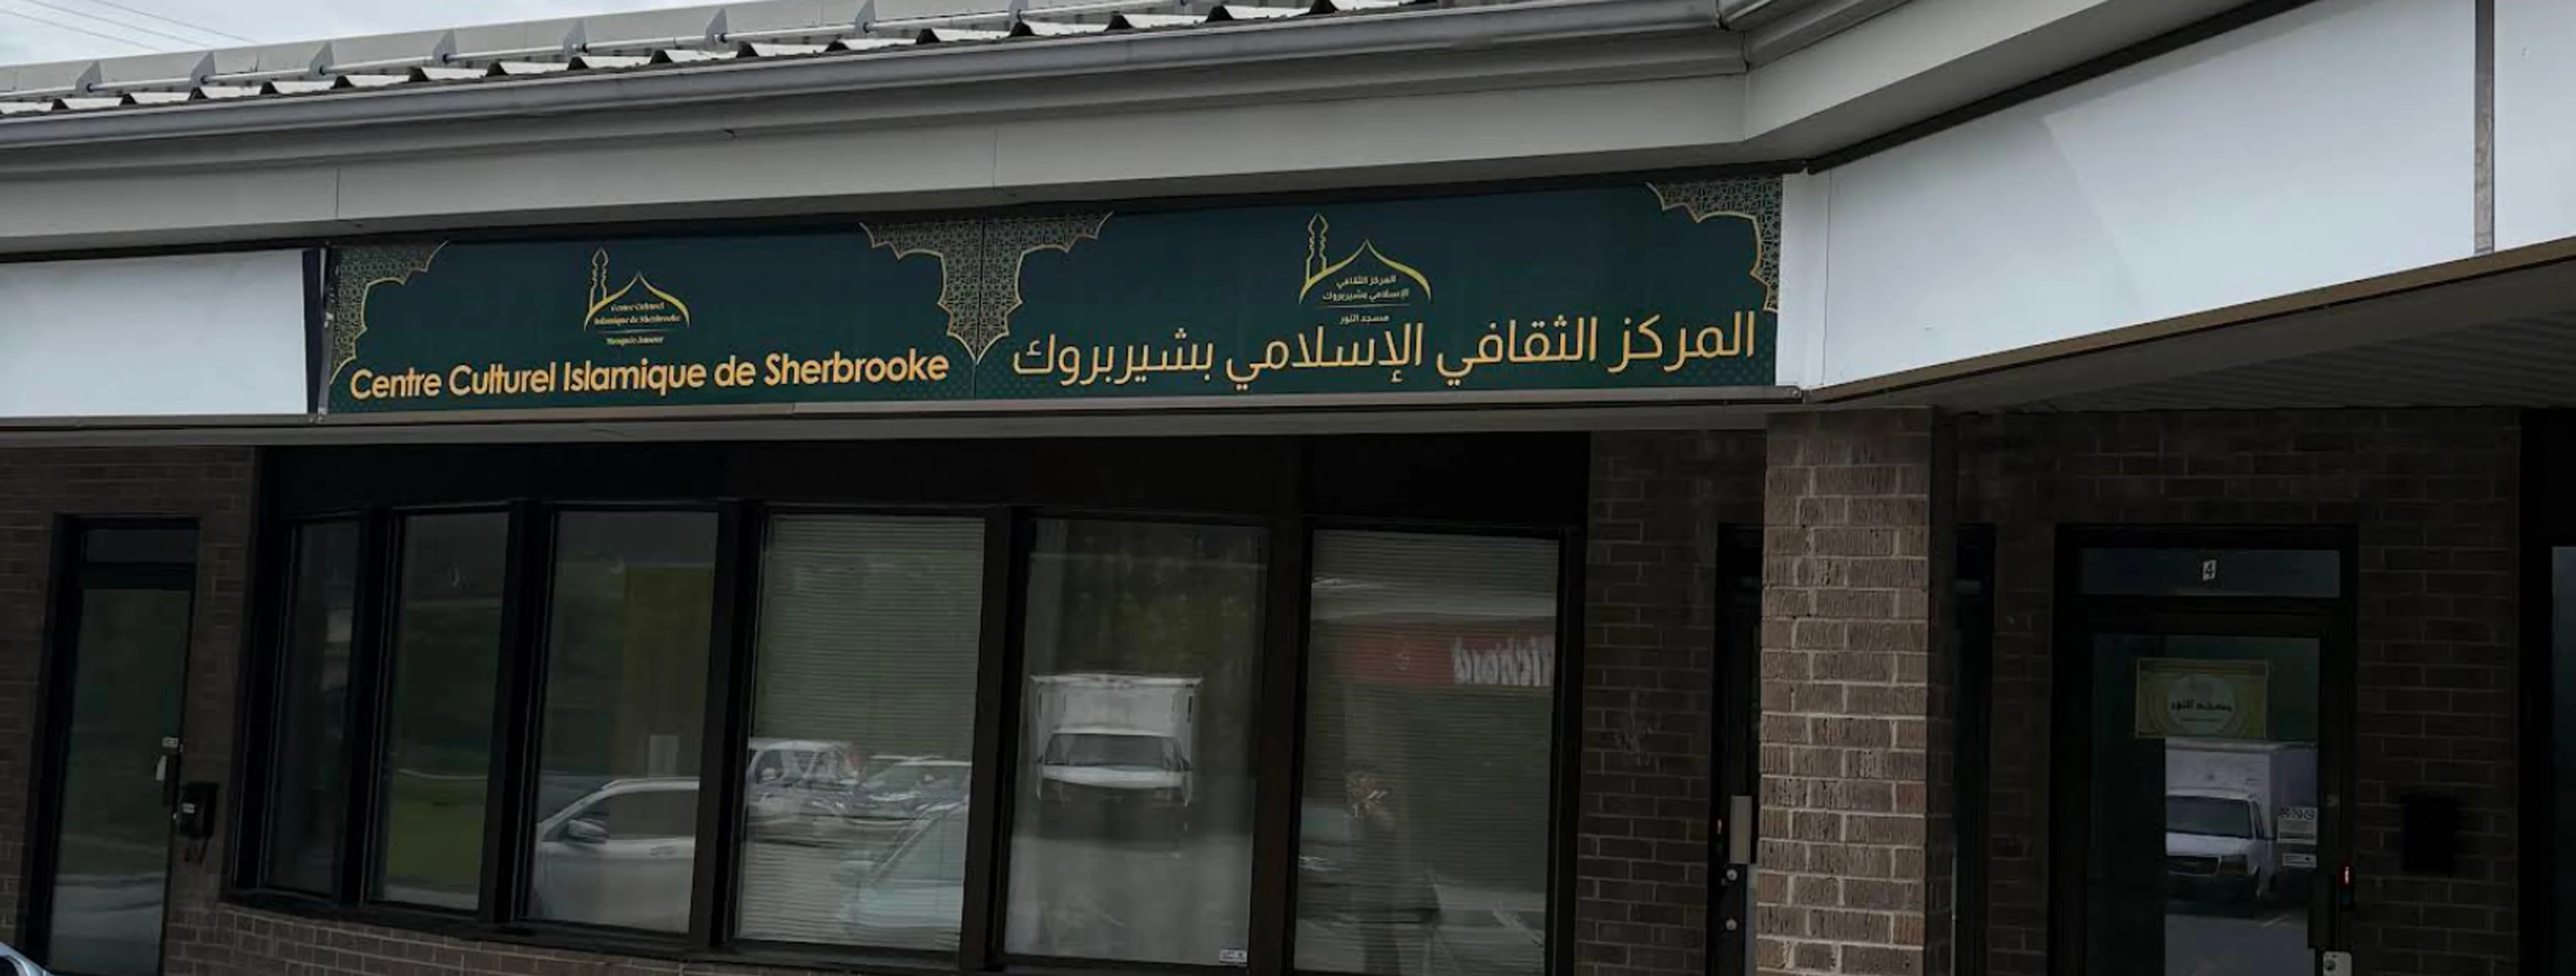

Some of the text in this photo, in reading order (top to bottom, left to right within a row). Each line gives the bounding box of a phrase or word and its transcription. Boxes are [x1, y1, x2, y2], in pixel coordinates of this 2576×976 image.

[350, 348, 949, 399] Centre Culturel Islamique de Sherbrooke
[1013, 311, 1755, 391] المركز الثقافي الإسلامي بشيربروك
